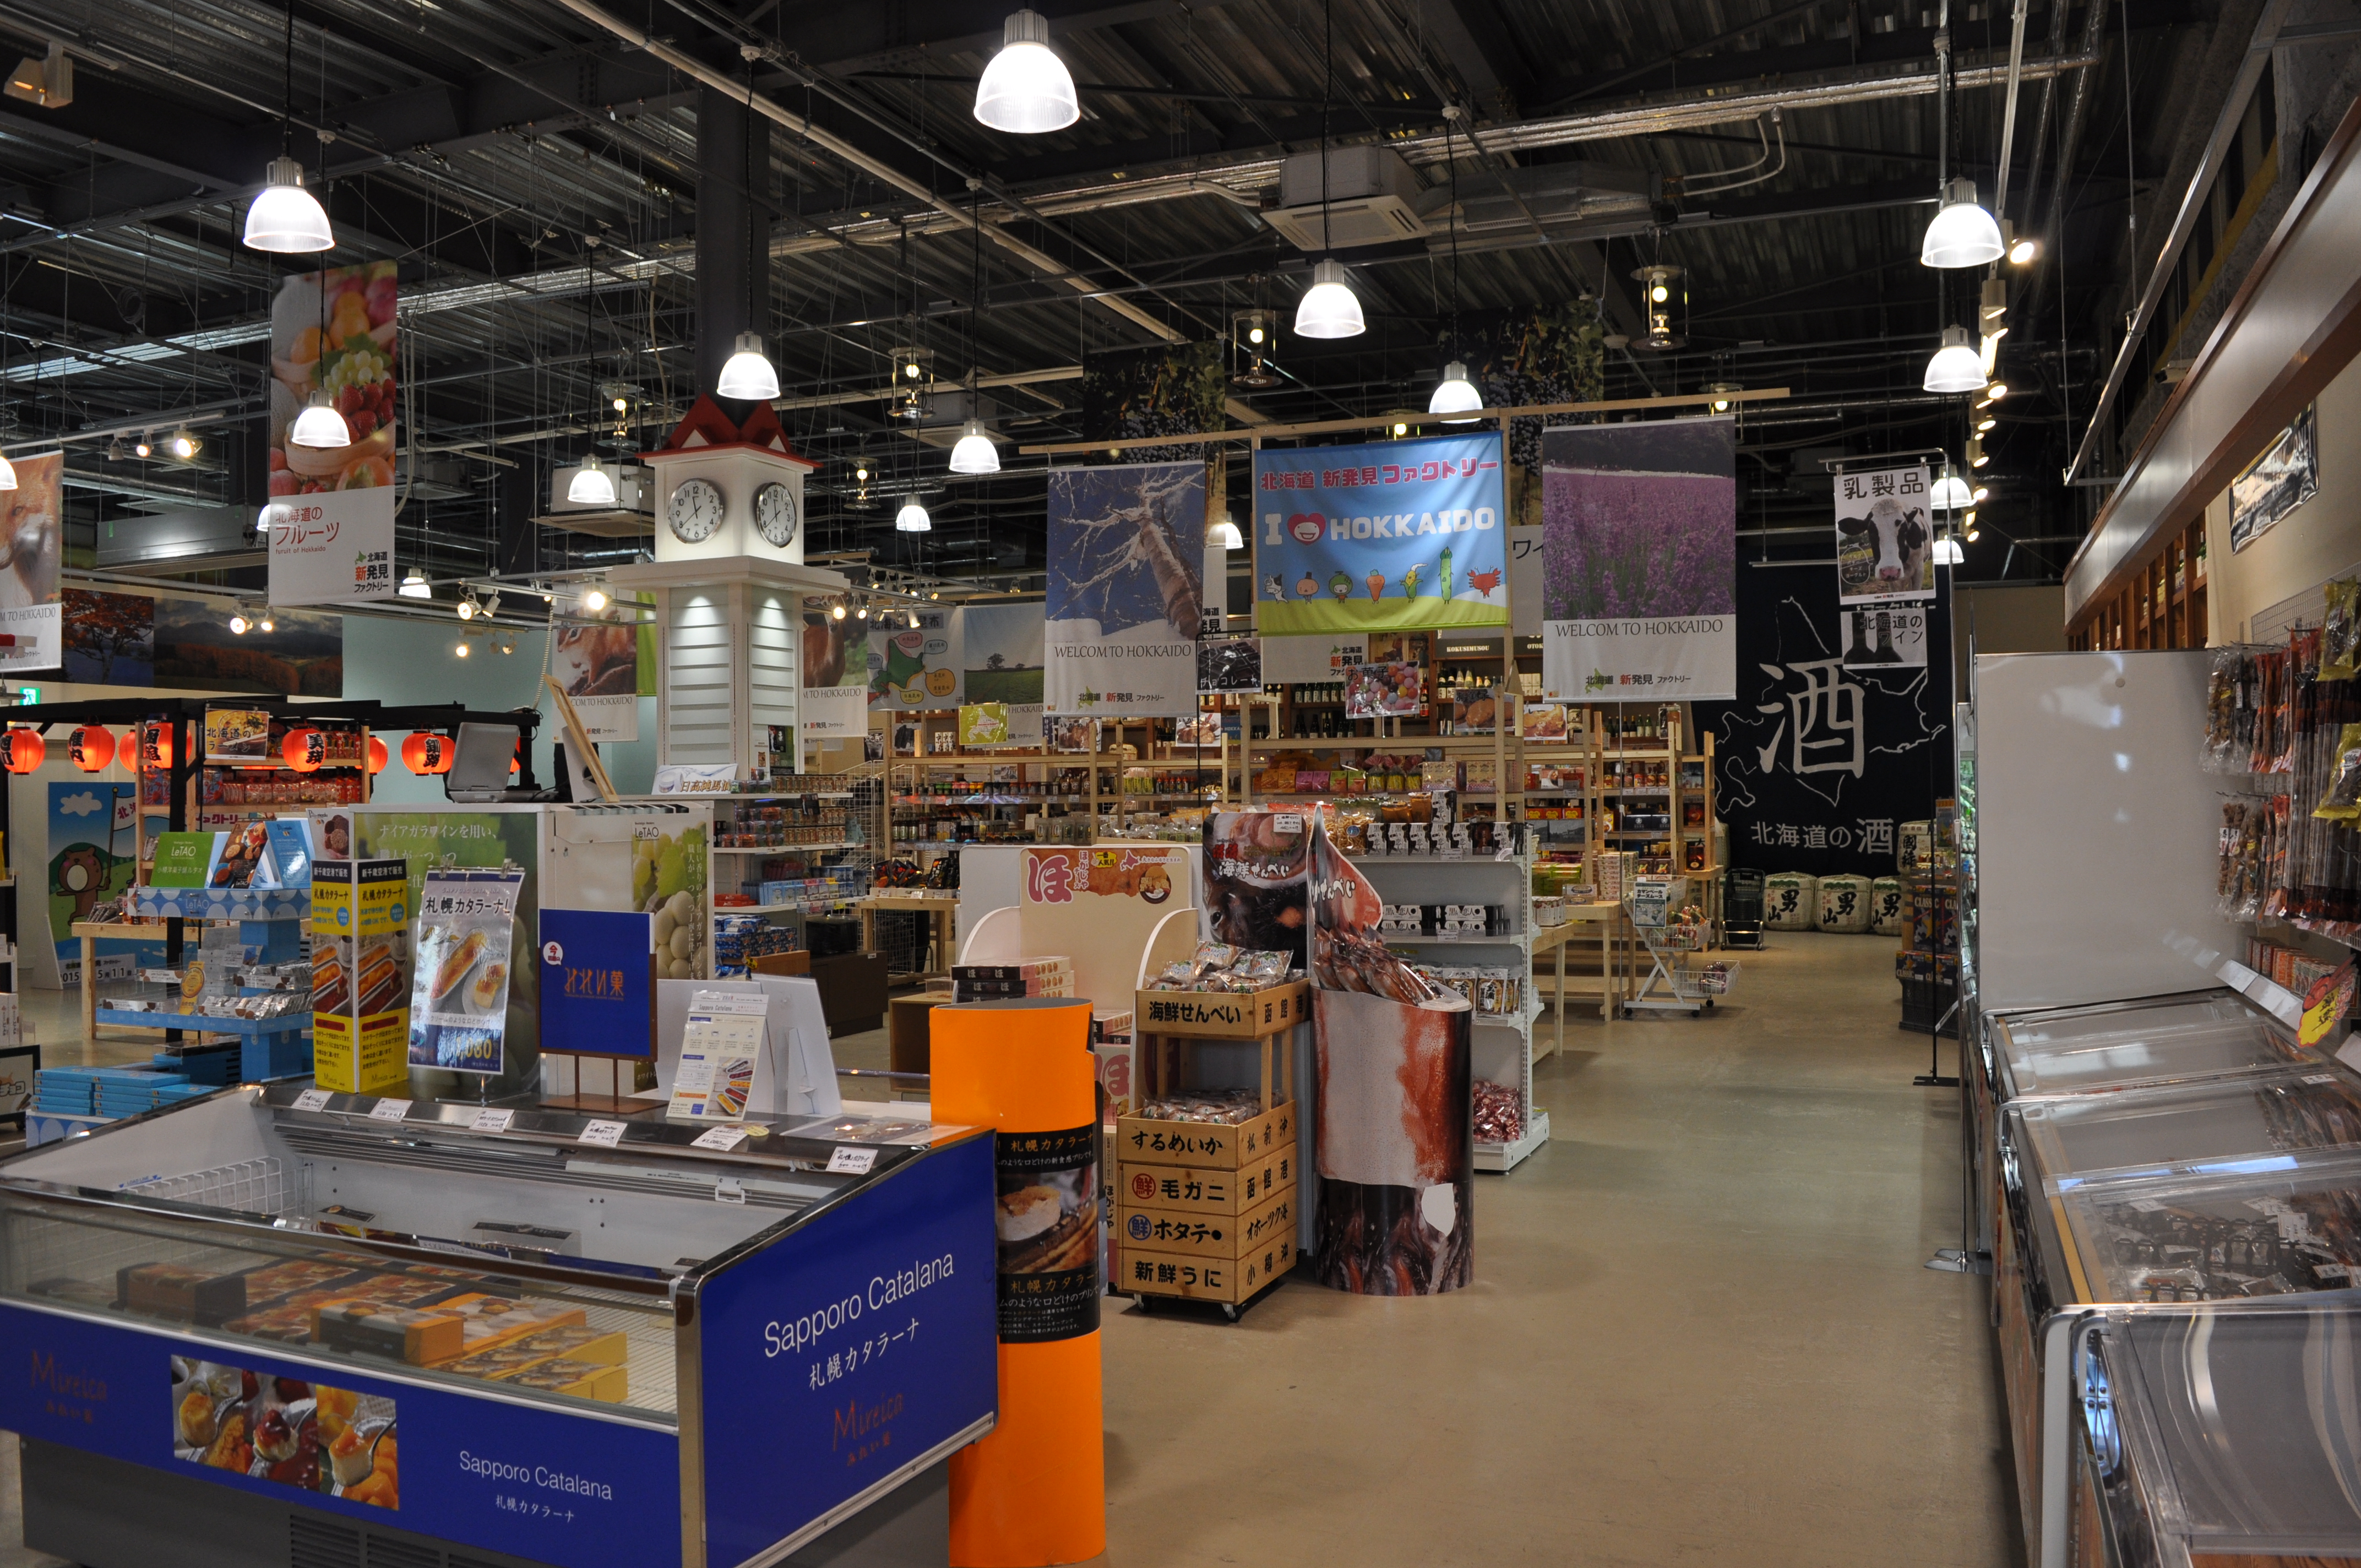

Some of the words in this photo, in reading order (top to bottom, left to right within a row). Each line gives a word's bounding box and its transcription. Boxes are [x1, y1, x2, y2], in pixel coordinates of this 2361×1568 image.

[1260, 471, 1315, 491] 北海道
[1322, 466, 1378, 488] 新発見
[1382, 457, 1498, 484] ファクトリー
[1843, 472, 1923, 499] 乳製品
[275, 507, 323, 523] 北海道の
[276, 522, 339, 546] フルーツ
[1265, 513, 1282, 545] I
[1330, 507, 1495, 541] HOKKAIDO
[367, 552, 388, 562] 北海道
[355, 564, 388, 581] 新発見
[354, 581, 389, 593] ファクトリー
[8, 611, 18, 621] TO
[19, 607, 56, 620] HOKKAIDO
[1203, 607, 1219, 616] 海道
[1555, 623, 1619, 637] WELCOM
[1622, 622, 1641, 635] TO
[1645, 619, 1723, 635] HOKKAIDO
[1860, 615, 1922, 630] 北海道の
[1879, 631, 1923, 645] ワイン
[1054, 645, 1108, 658] WELCOM
[1109, 646, 1123, 657] TO
[1126, 644, 1191, 657] HOKKAIDO
[1330, 655, 1363, 667] 新発見
[1347, 666, 1389, 681] お菓子
[1586, 675, 1614, 685] 北海道
[1620, 674, 1653, 685] 新発見
[570, 698, 587, 706] COM
[597, 696, 632, 706] HOKKAIDO
[809, 689, 819, 699] TO
[820, 688, 861, 698] HOKKAIDO
[1078, 693, 1101, 701] 北海道
[1106, 692, 1133, 702] 新発見
[1456, 690, 1489, 703] お菓子
[1012, 705, 1043, 714] HOKKAID
[1756, 658, 1865, 778] 酒
[206, 727, 251, 739] 北海道の
[209, 741, 251, 753] ラーメン
[635, 827, 659, 839] LeTAO
[1750, 818, 1894, 854] 北海道の酒
[171, 846, 196, 856] LeTAO
[1219, 861, 1289, 878] 海鮮せんべい
[1029, 855, 1073, 903] ほ
[314, 888, 349, 901] 札幌カタラーナ
[362, 887, 404, 901] 札幌カタラーナ
[1914, 897, 1940, 908] CLASSC
[549, 945, 558, 956] 今
[1149, 1001, 1241, 1023] 海鮮せんべい
[1264, 994, 1303, 1024] 函館港
[1010, 1132, 1094, 1152] 札幌カタラーナ
[1131, 1130, 1223, 1156] するめいか
[997, 1151, 1094, 1166] のような口どけの新食感プリンです。
[1247, 1159, 1288, 1200] 函館港
[1135, 1176, 1153, 1196] 鮮
[1161, 1179, 1225, 1201] 毛ガニ
[1247, 1201, 1288, 1242] オホーツク海
[1131, 1218, 1149, 1237] 鮮
[1154, 1218, 1210, 1244] ホタテ
[1247, 1242, 1288, 1286] 小樽沖
[1135, 1261, 1222, 1288] 新鮮うに
[765, 1294, 862, 1358] Sapporo
[868, 1254, 954, 1310] Catalana
[809, 1317, 919, 1391] 札幌カタラーナ
[833, 1393, 904, 1452] Mireica
[460, 1450, 530, 1483] Sapporo
[535, 1466, 612, 1500] Catalana
[496, 1494, 574, 1523] 札幌カタラーナ
